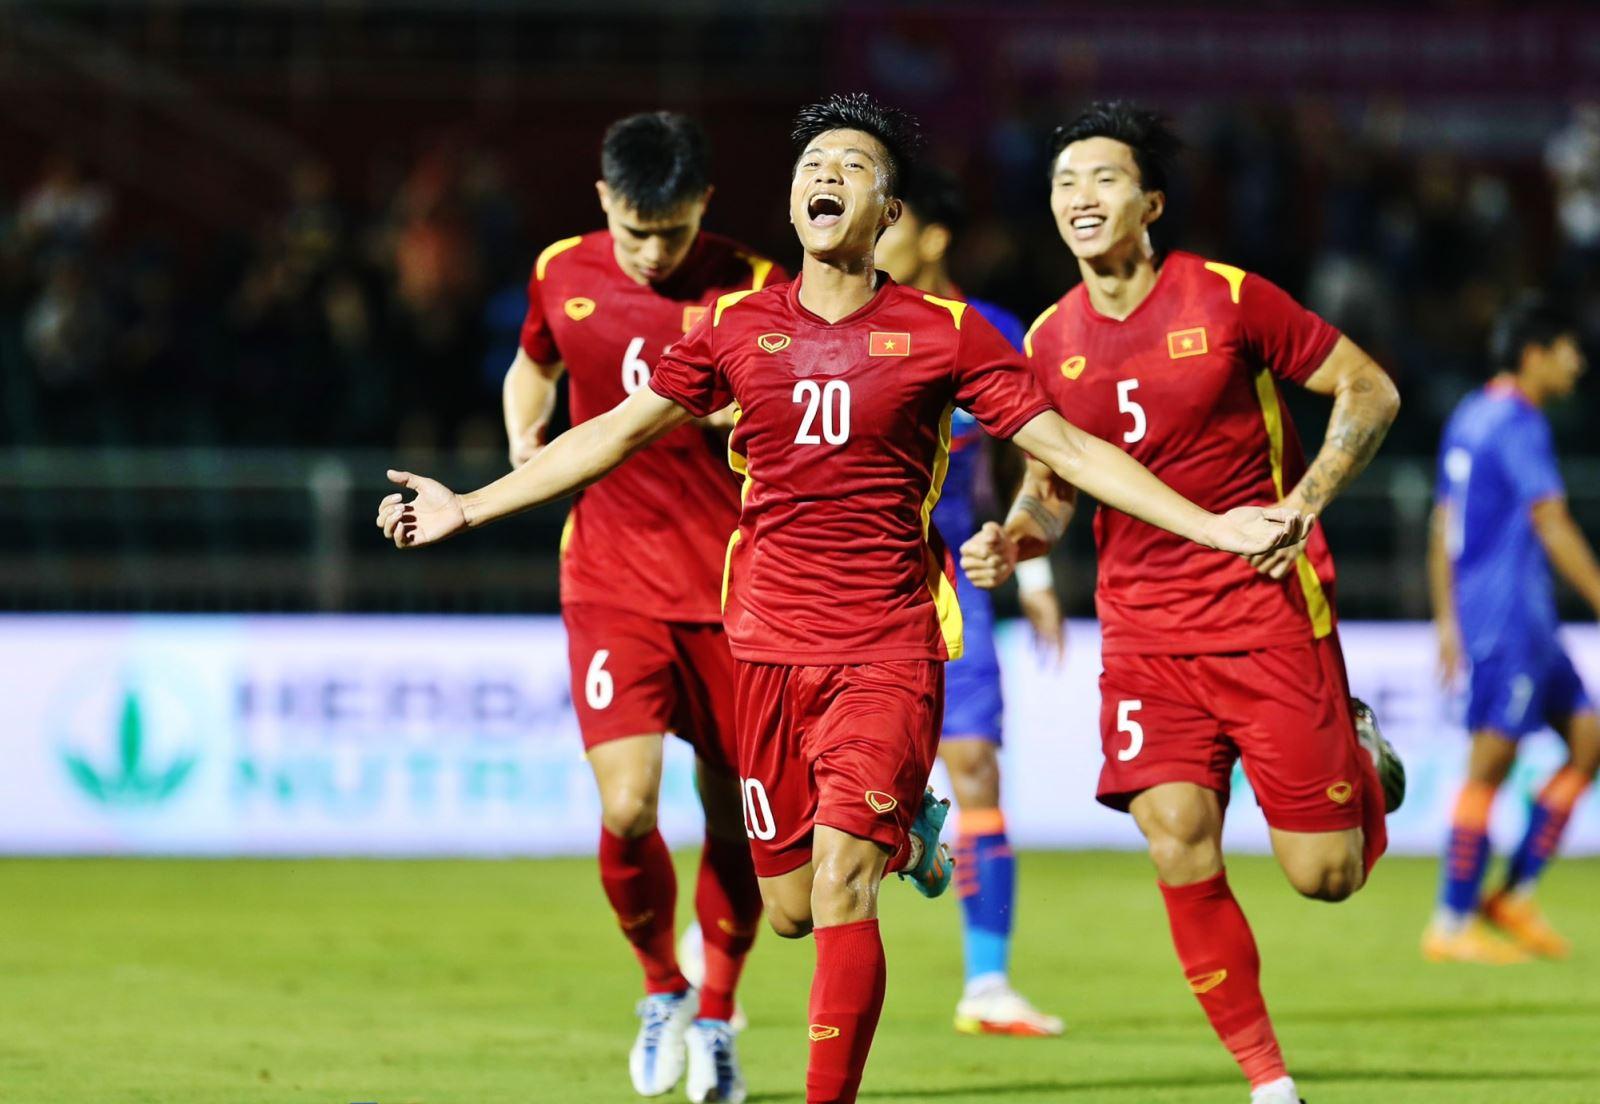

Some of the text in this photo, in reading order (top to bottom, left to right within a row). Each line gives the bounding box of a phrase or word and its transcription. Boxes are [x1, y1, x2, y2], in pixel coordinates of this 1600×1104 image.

[792, 379, 851, 446] 20
[1116, 378, 1147, 444] 5
[585, 649, 614, 710] 6
[1117, 699, 1144, 762] 5
